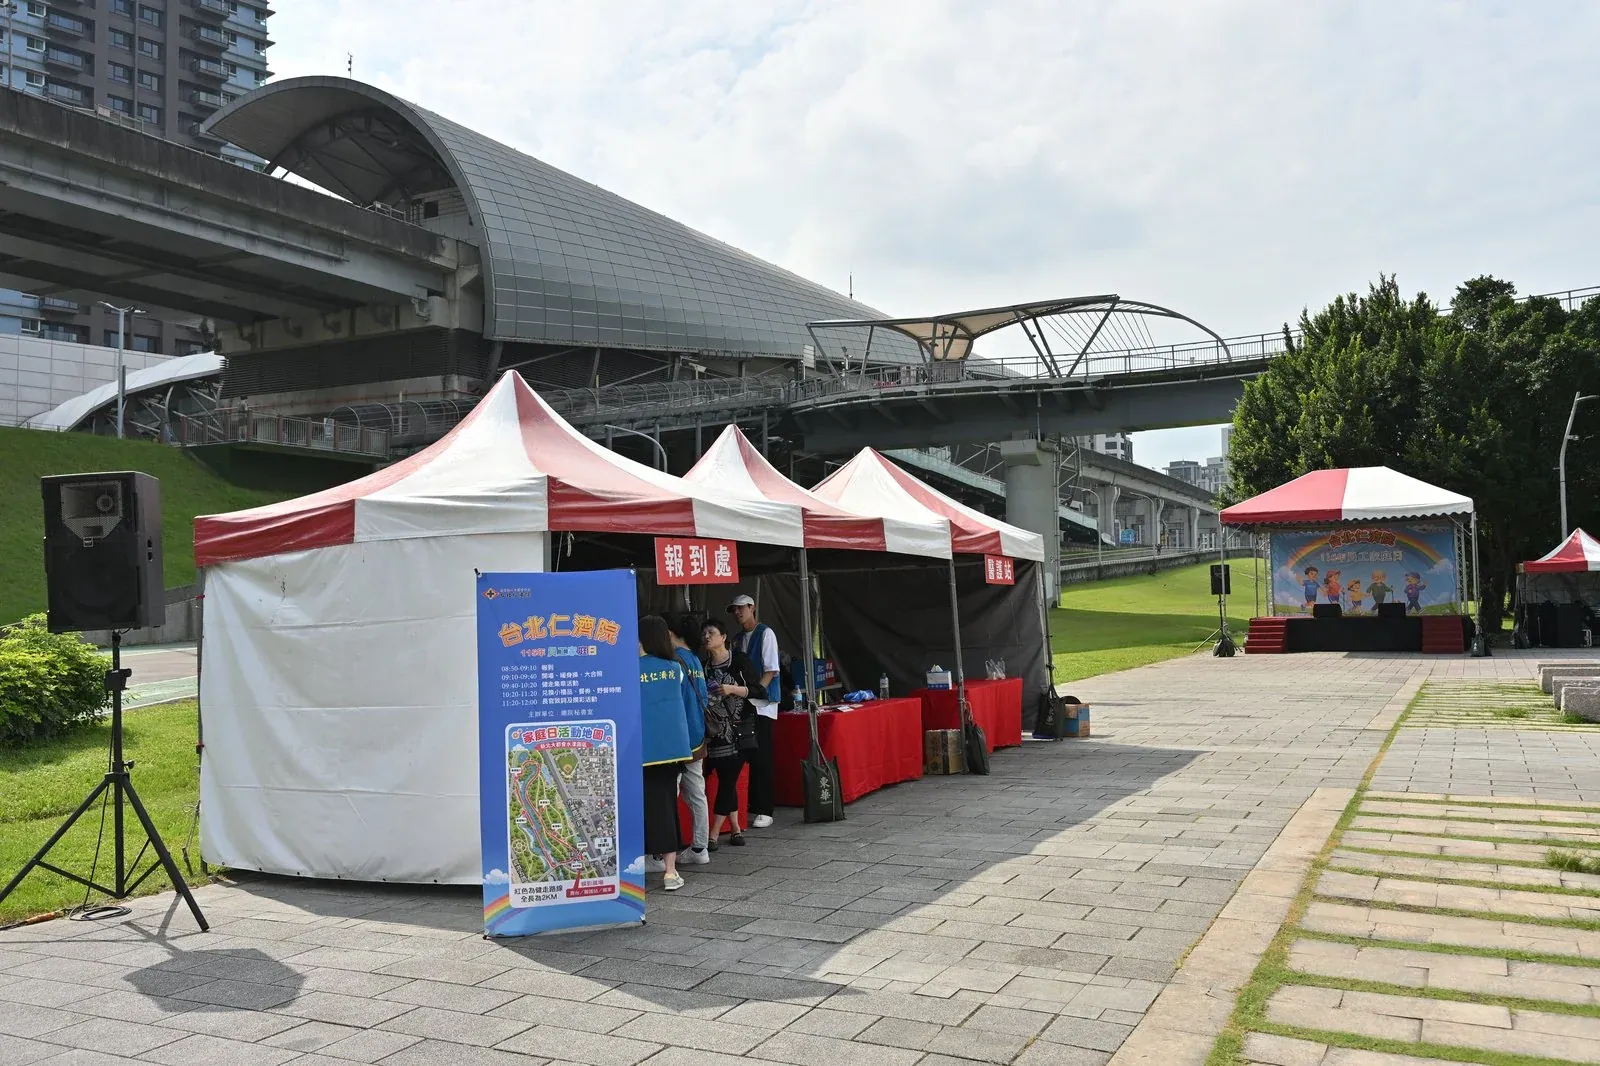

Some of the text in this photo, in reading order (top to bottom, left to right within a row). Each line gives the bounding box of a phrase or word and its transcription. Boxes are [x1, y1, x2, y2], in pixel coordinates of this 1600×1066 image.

[664, 544, 732, 577] 報到處
[988, 558, 1012, 580] 醫護站
[498, 613, 621, 647] 台北仁濟院
[502, 682, 538, 690] 09:40-10:20
[502, 690, 538, 698] 10:20-11:20
[502, 699, 538, 707] 11:20-12:00
[522, 726, 604, 744] 家庭日活動地圖
[820, 776, 831, 800] 東華
[514, 886, 563, 895] 紅色為健走路線
[520, 894, 558, 903] 全長為2KM
